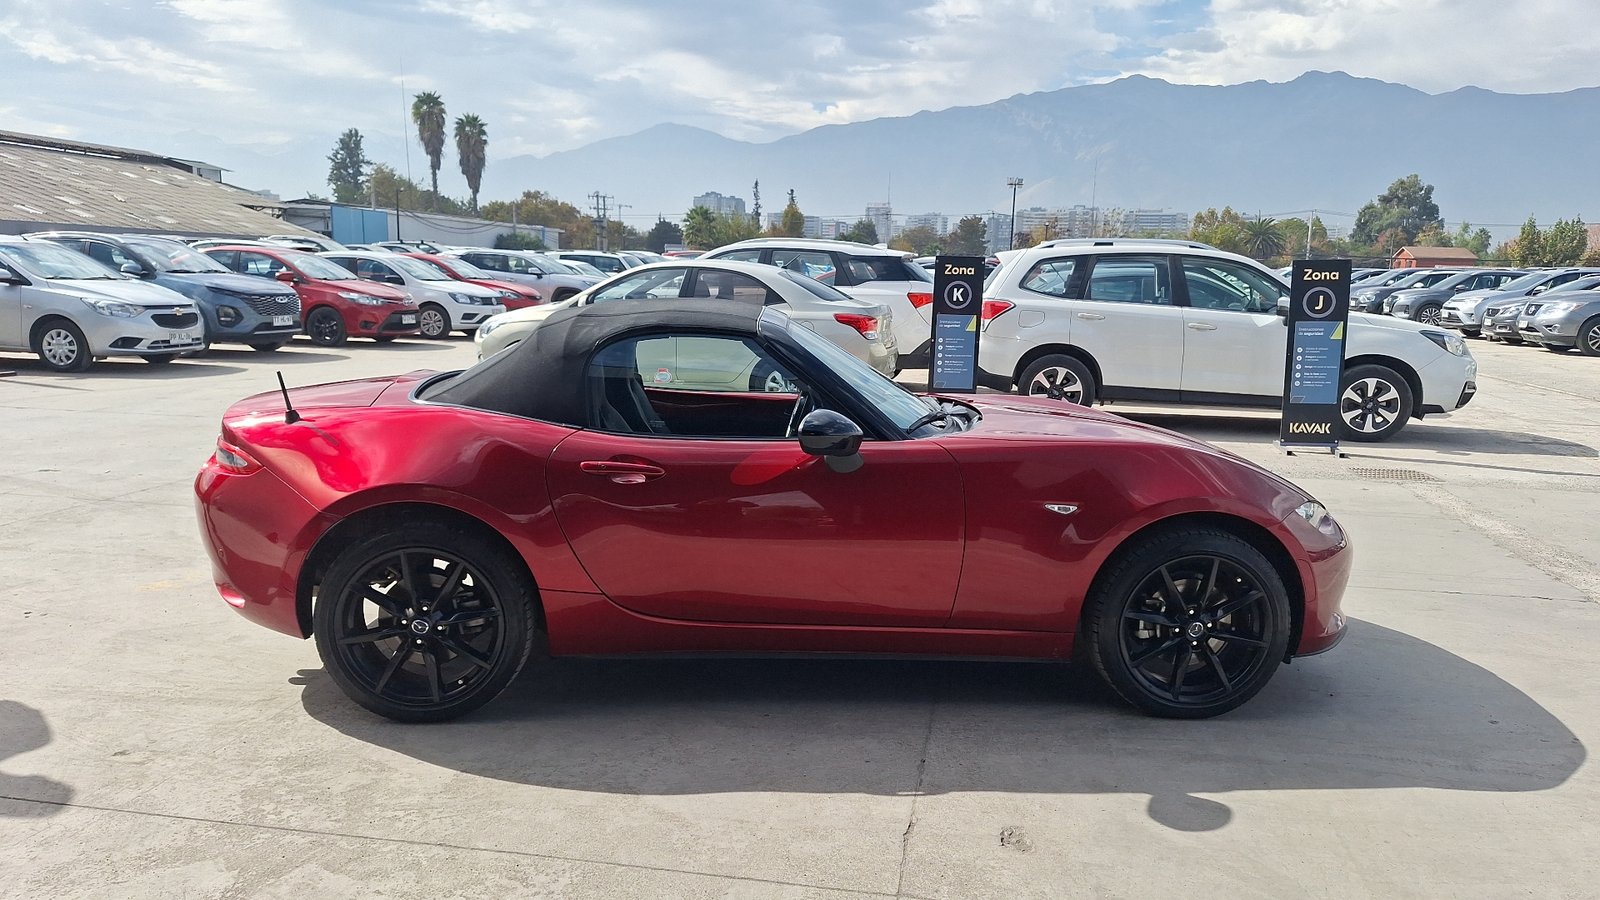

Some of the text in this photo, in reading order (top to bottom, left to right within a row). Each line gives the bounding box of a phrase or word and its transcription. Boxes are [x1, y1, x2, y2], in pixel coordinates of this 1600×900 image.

[944, 264, 975, 275] Zona
[1303, 268, 1340, 281] Zona
[952, 287, 965, 302] K
[1314, 295, 1324, 310] J
[1289, 422, 1331, 434] KAVAK
